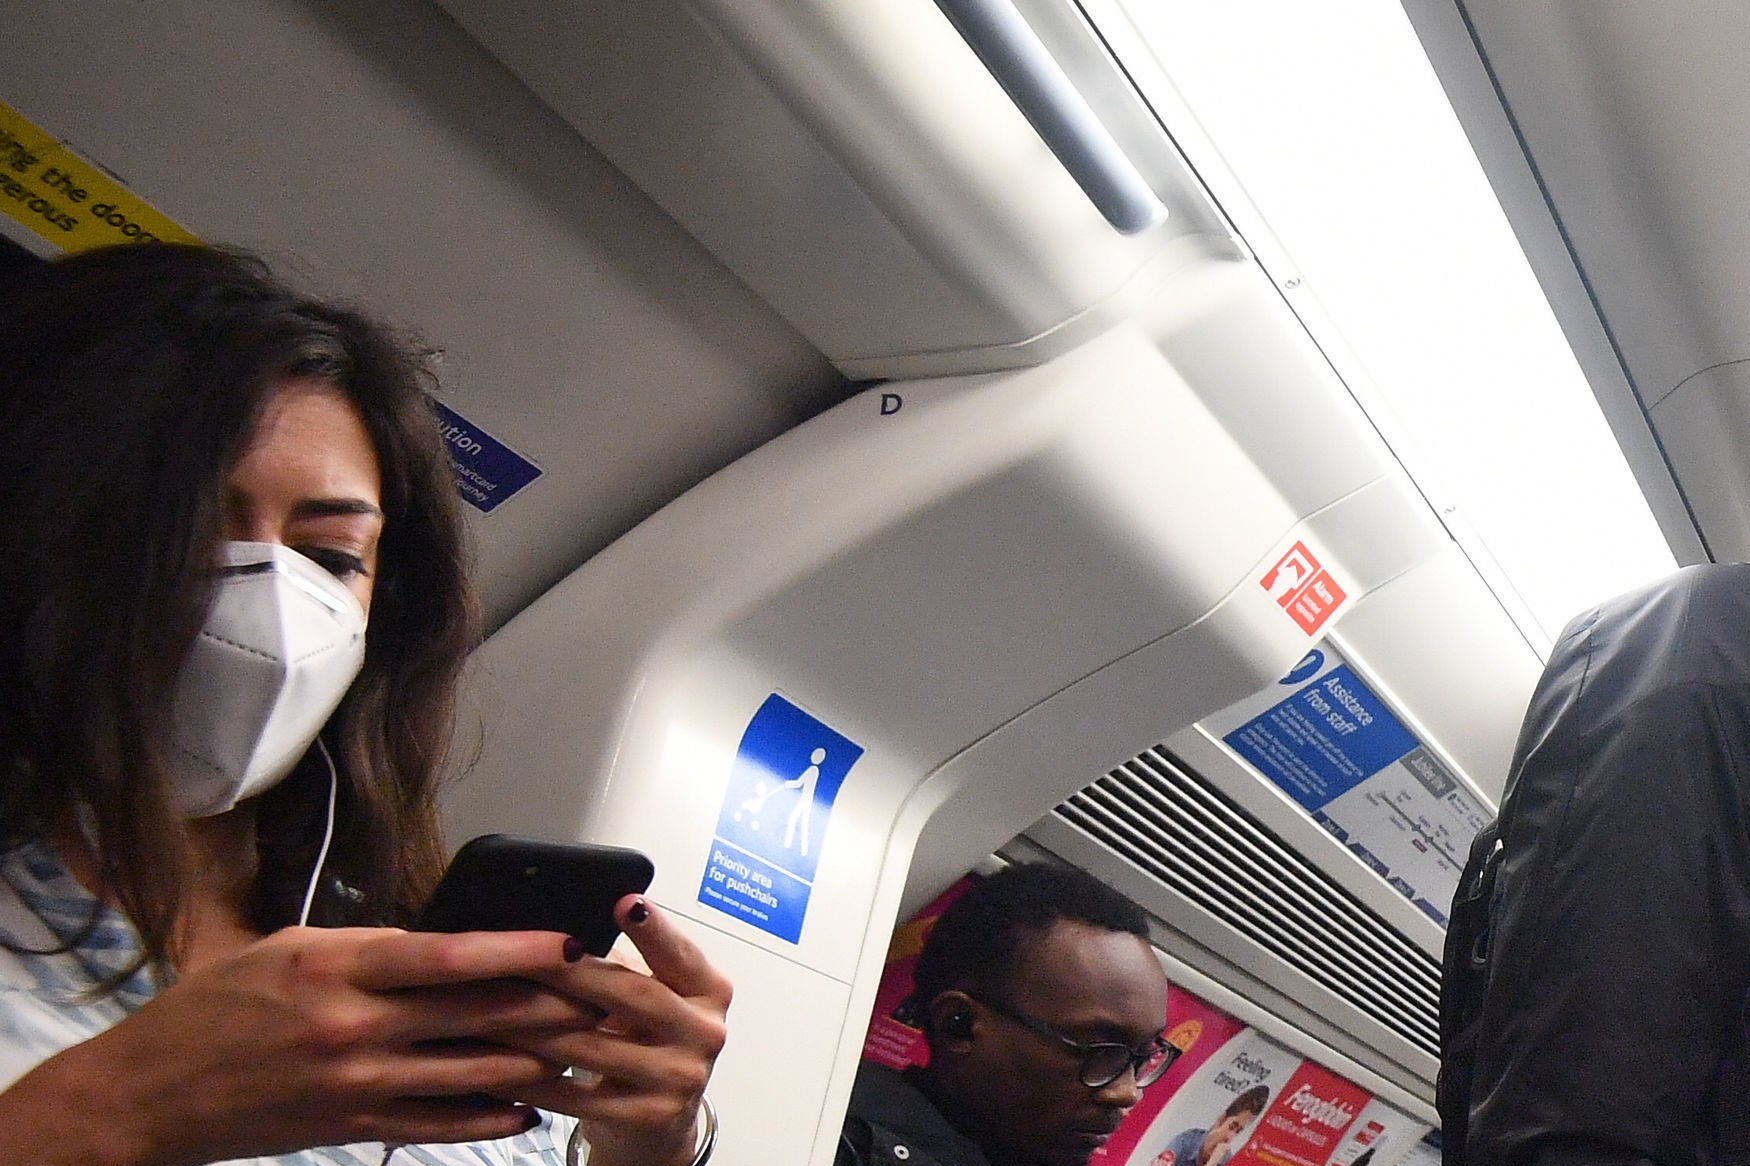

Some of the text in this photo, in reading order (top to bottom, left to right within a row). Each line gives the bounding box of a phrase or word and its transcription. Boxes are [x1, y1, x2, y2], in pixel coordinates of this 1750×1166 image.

[40, 167, 88, 204] the
[91, 203, 162, 244] door
[880, 393, 903, 416] D
[452, 461, 497, 491] martcard
[456, 478, 490, 502] ourney
[1311, 580, 1334, 606] Alarm
[1303, 689, 1358, 737] from staff
[1322, 676, 1374, 728] Assistance
[713, 850, 773, 889] Priority area
[709, 866, 779, 910] for pushchairs
[1213, 1070, 1250, 1095] tired?
[1231, 1051, 1272, 1083] Feeling
